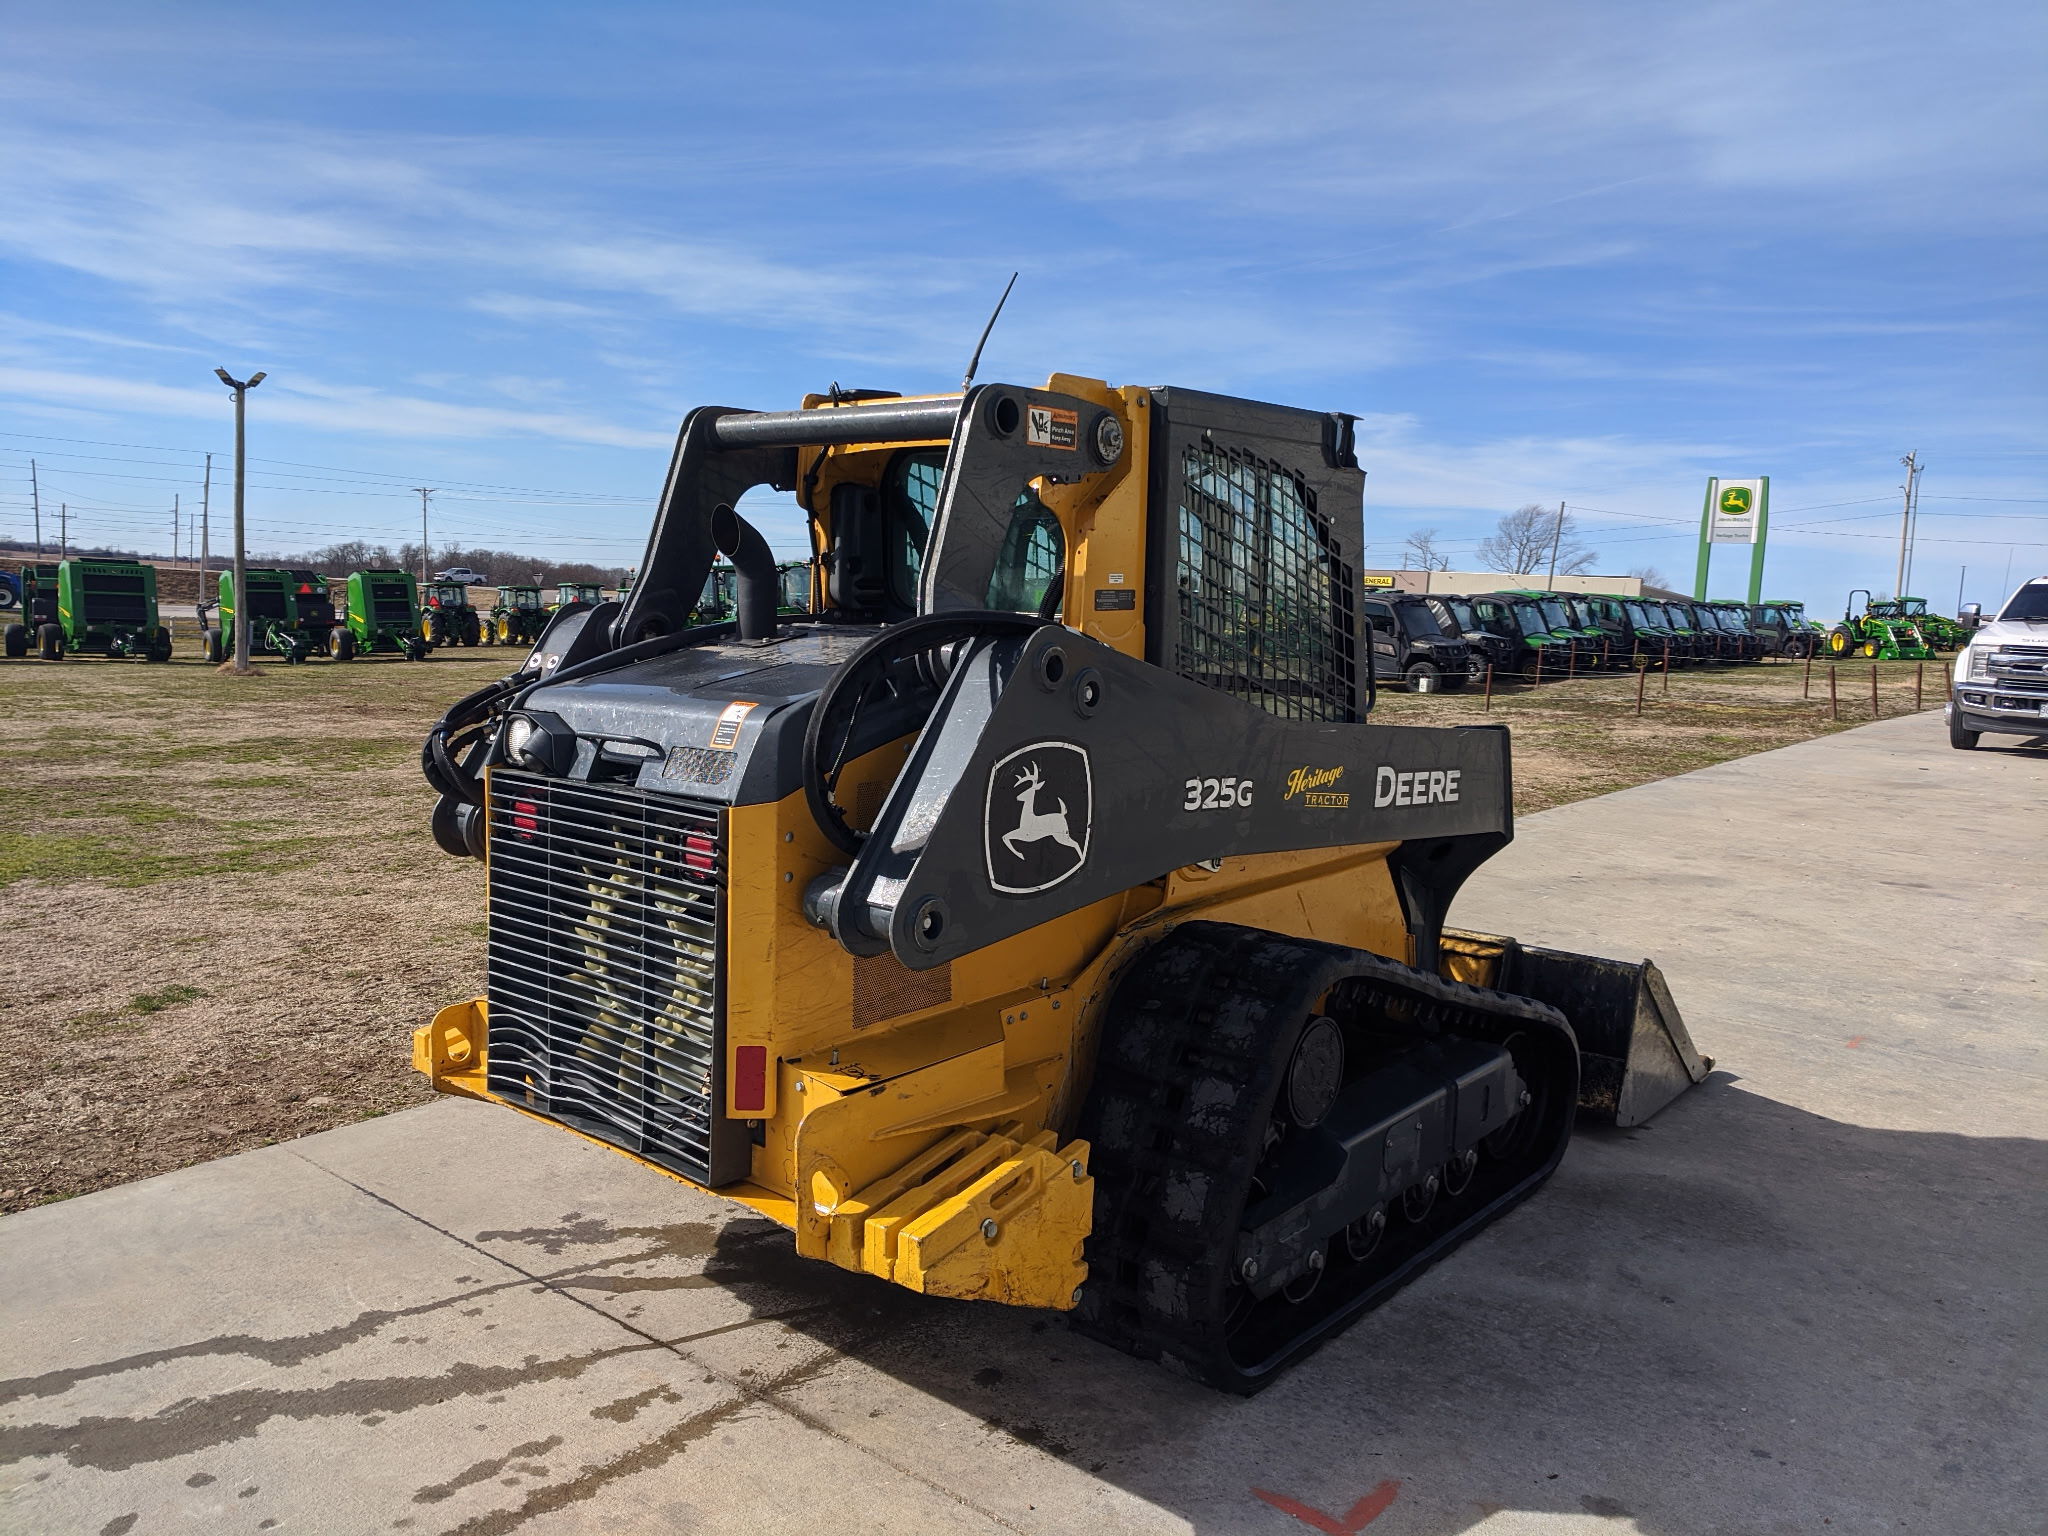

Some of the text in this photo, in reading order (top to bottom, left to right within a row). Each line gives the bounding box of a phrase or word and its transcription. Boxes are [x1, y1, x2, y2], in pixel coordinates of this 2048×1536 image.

[1052, 426, 1064, 434] Pinch
[1364, 577, 1391, 585] ENERAL
[1184, 777, 1253, 811] 325G
[1284, 765, 1344, 800] Heritage
[1374, 766, 1461, 808] DEERE
[1305, 794, 1350, 806] TRACTOR
